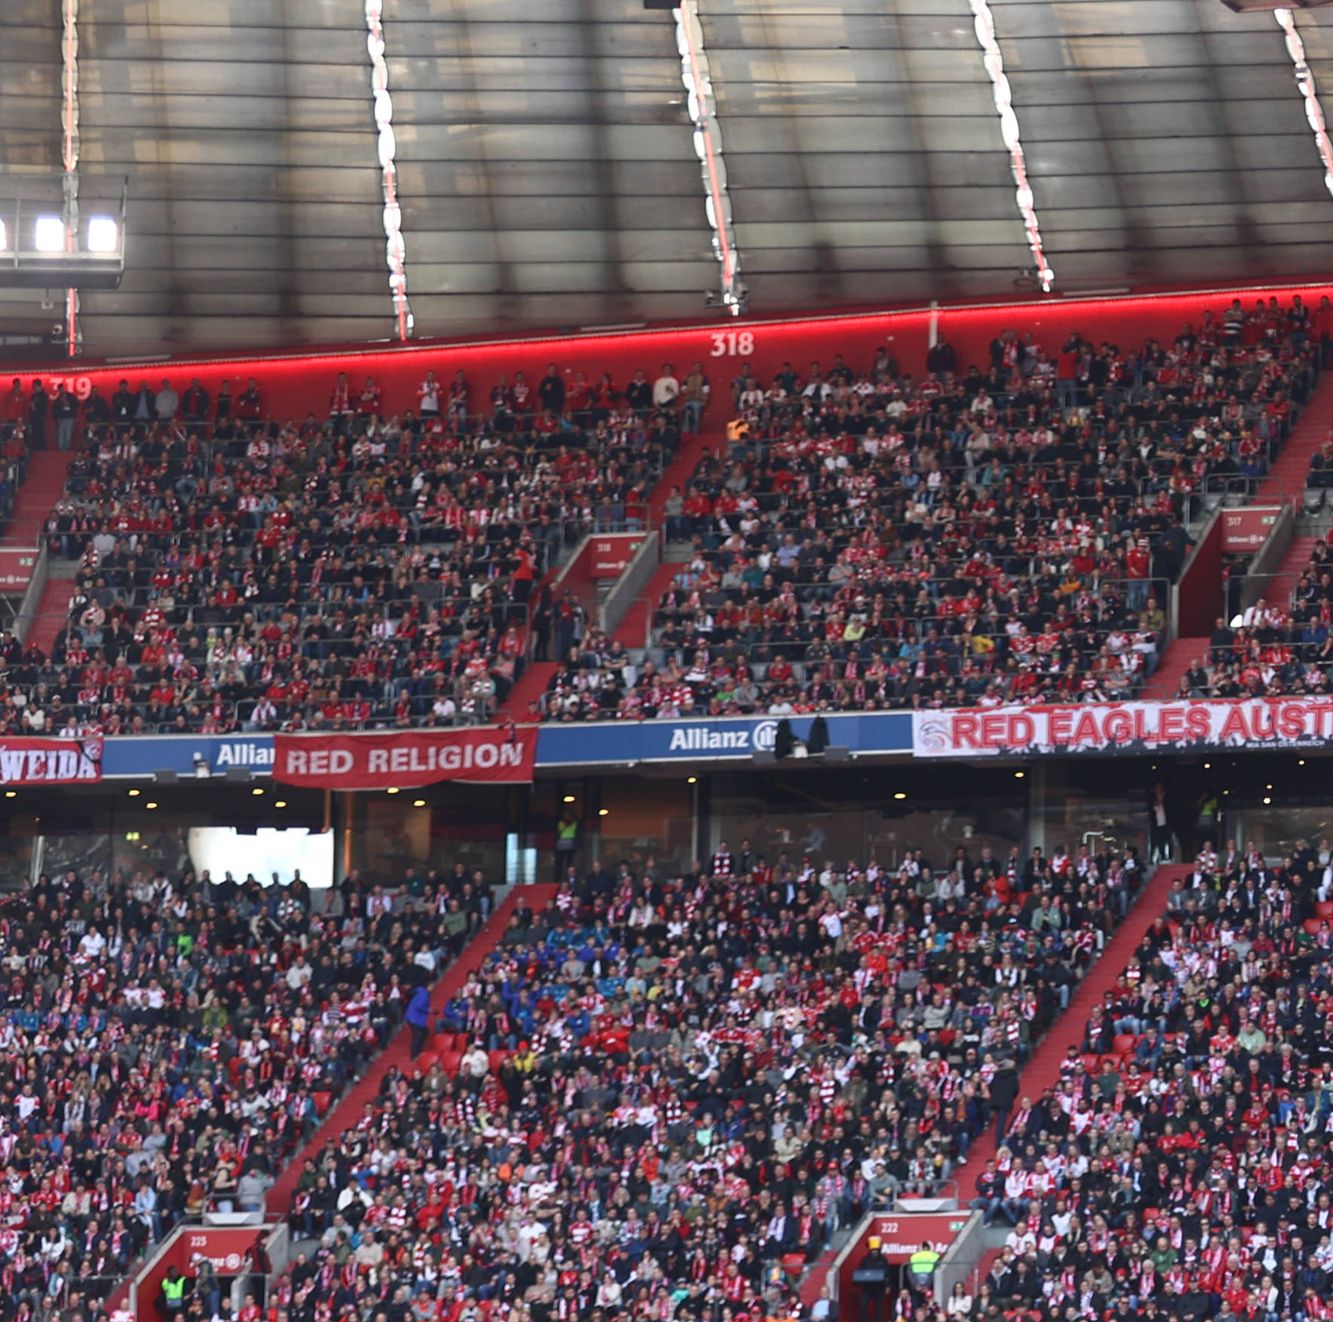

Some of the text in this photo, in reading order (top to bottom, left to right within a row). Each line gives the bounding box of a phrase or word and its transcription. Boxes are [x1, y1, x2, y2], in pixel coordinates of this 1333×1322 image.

[711, 333, 754, 356] 318
[670, 729, 749, 751] Allianz
[952, 713, 1036, 749] RED
[1048, 706, 1211, 746] EAGLES
[286, 743, 525, 775] RED RELIGION
